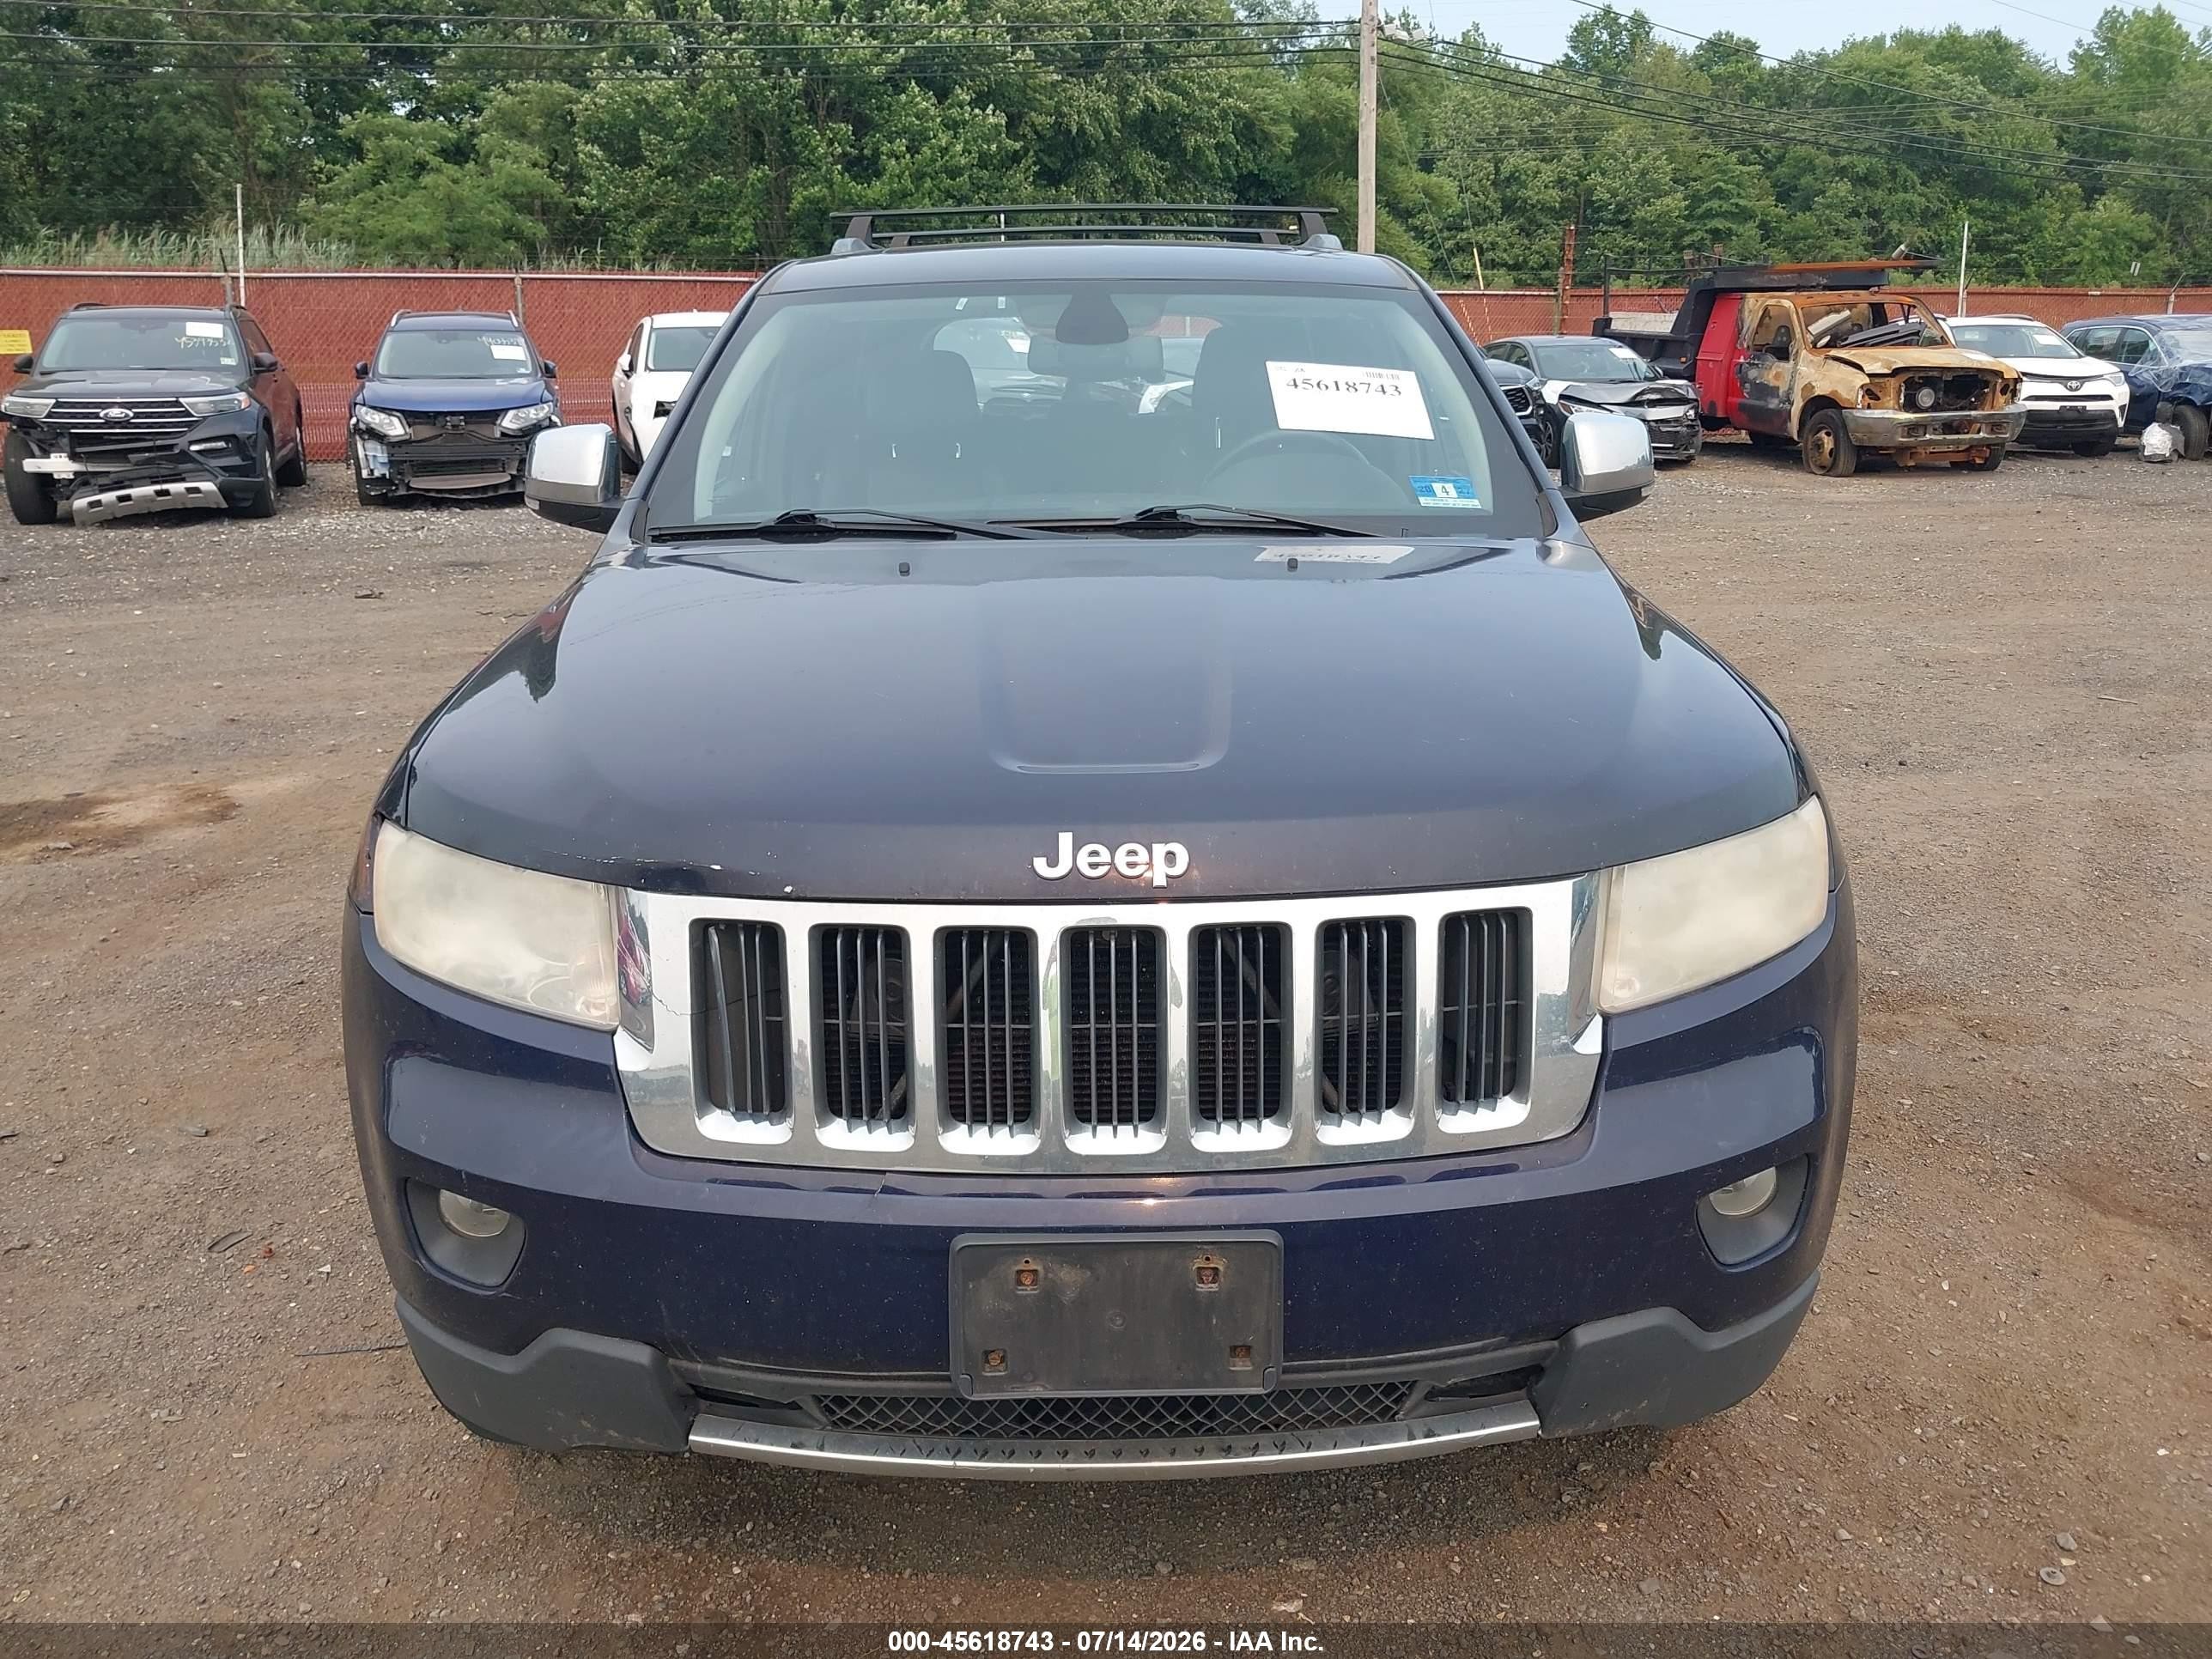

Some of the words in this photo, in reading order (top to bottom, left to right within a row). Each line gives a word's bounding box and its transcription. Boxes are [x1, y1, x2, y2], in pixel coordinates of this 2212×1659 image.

[1286, 377, 1402, 397] 45618743
[1441, 485, 1449, 496] 4
[1032, 831, 1190, 888] Jeep
